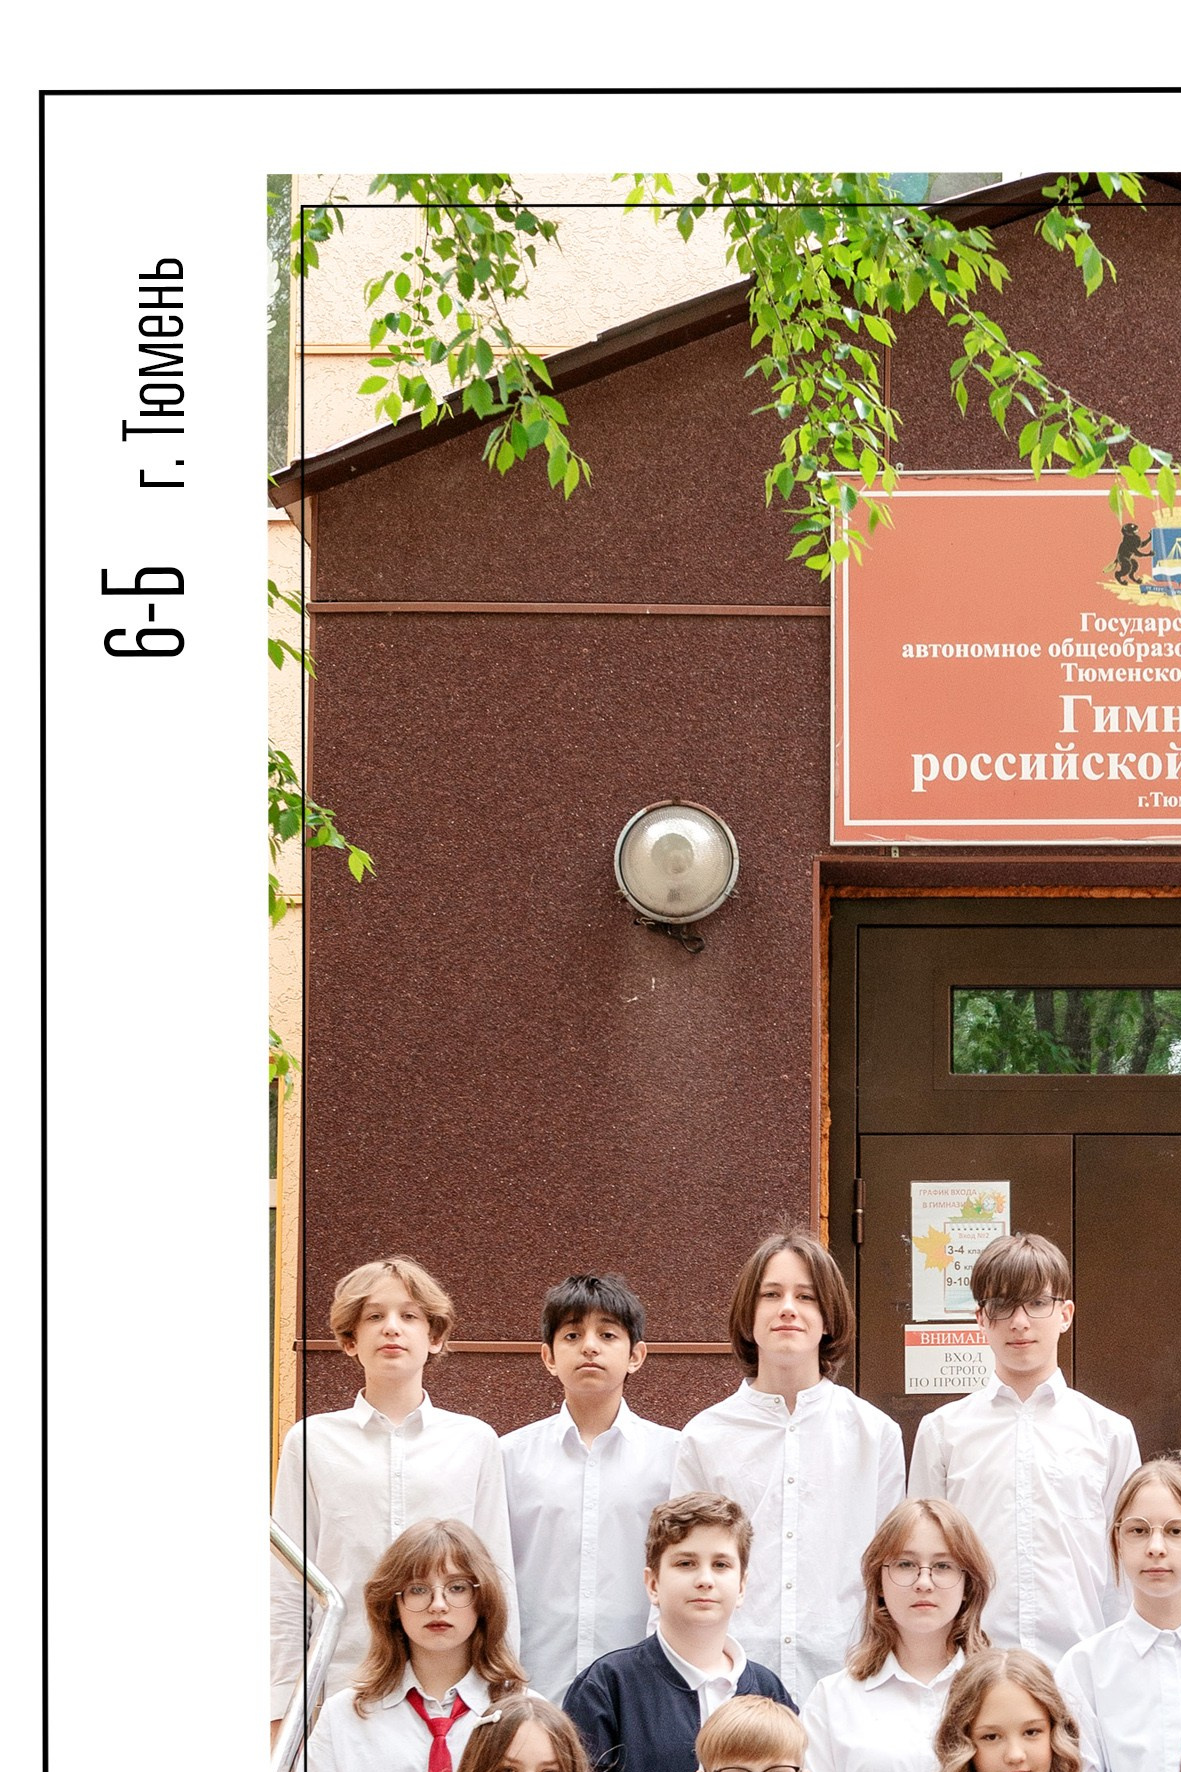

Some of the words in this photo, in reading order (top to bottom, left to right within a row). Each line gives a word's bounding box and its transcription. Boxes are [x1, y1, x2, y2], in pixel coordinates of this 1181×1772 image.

[902, 643, 1042, 659] автономное
[919, 1188, 949, 1197] ГРАФИК
[951, 1188, 977, 1197] ВХОДА
[947, 1245, 964, 1255] 3-4
[954, 1261, 961, 1271] 6
[946, 1277, 970, 1287] 9-10
[920, 1332, 986, 1345] ВНИМАН
[945, 1352, 983, 1363] ВХОД
[940, 1366, 987, 1375] СТРОГО
[909, 1377, 930, 1388] ПО
[934, 1376, 990, 1387] ПРОПУС
